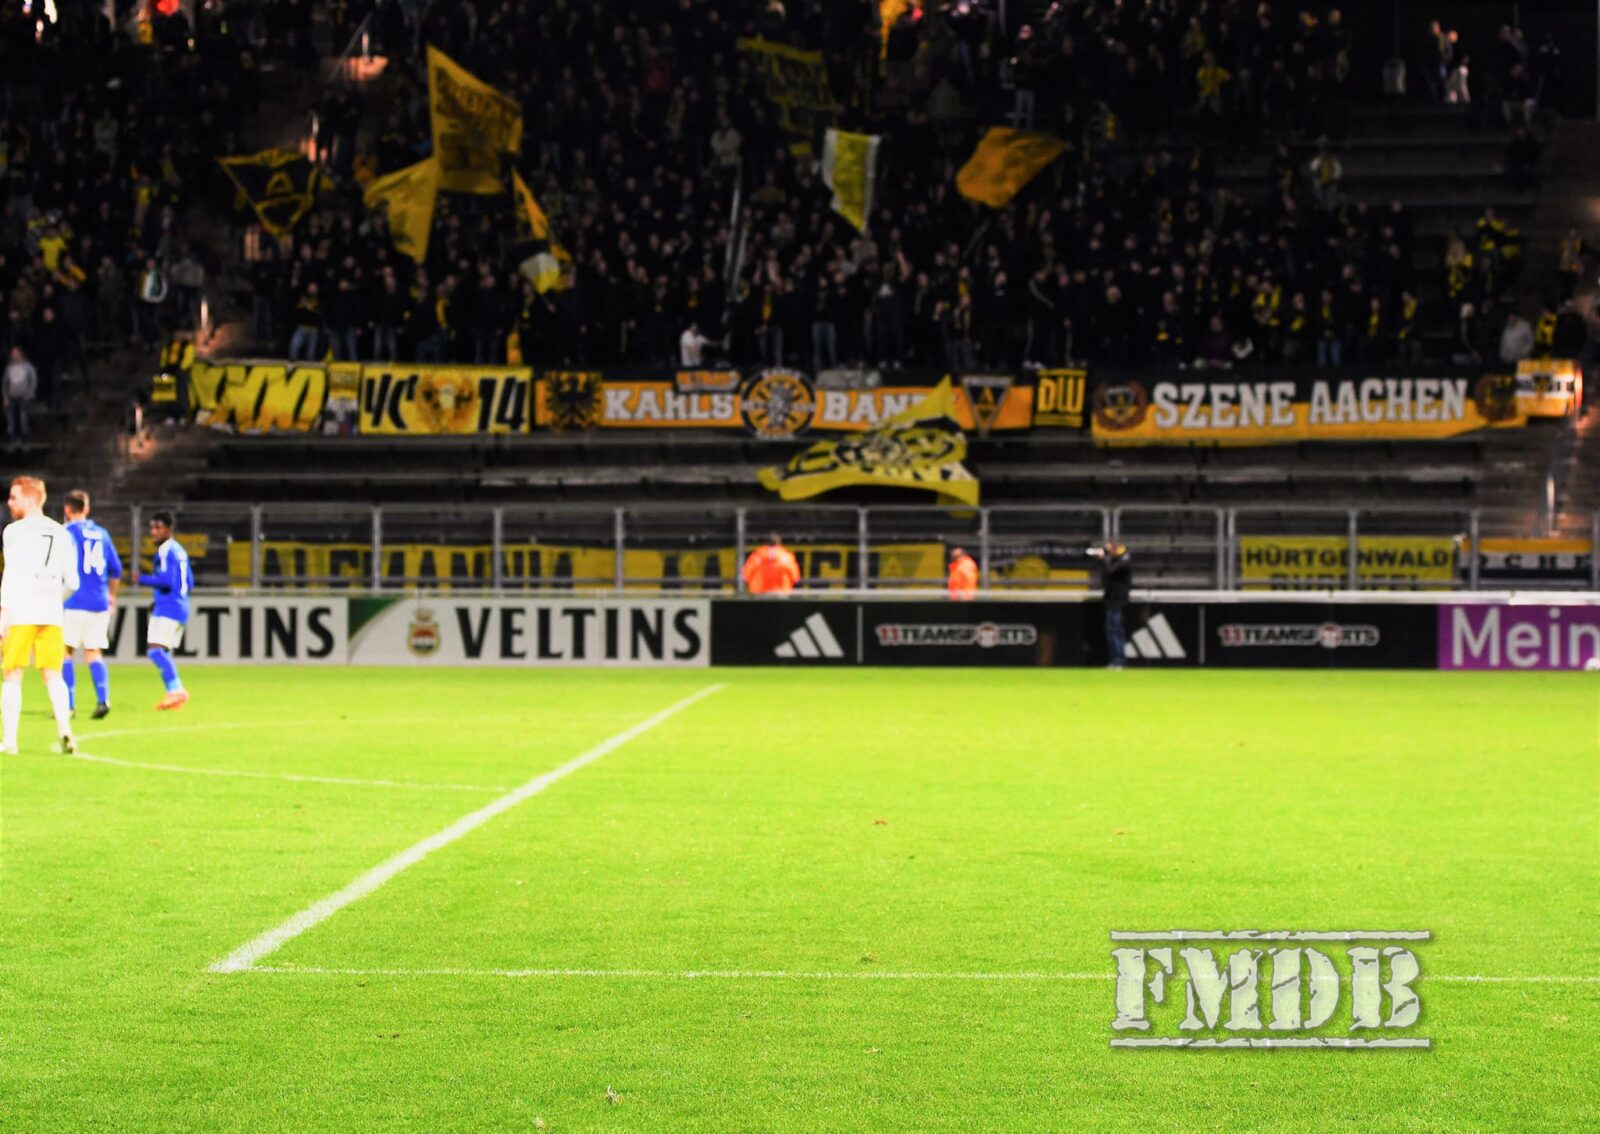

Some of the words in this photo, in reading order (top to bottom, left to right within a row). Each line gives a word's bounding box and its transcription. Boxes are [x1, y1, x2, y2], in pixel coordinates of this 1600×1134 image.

[1153, 382, 1296, 428] SZENE
[1309, 378, 1468, 424] AACHEN
[41, 534, 54, 567] 7
[83, 539, 107, 576] 14
[455, 607, 702, 660] VELTINS
[1453, 606, 1600, 668] Mein
